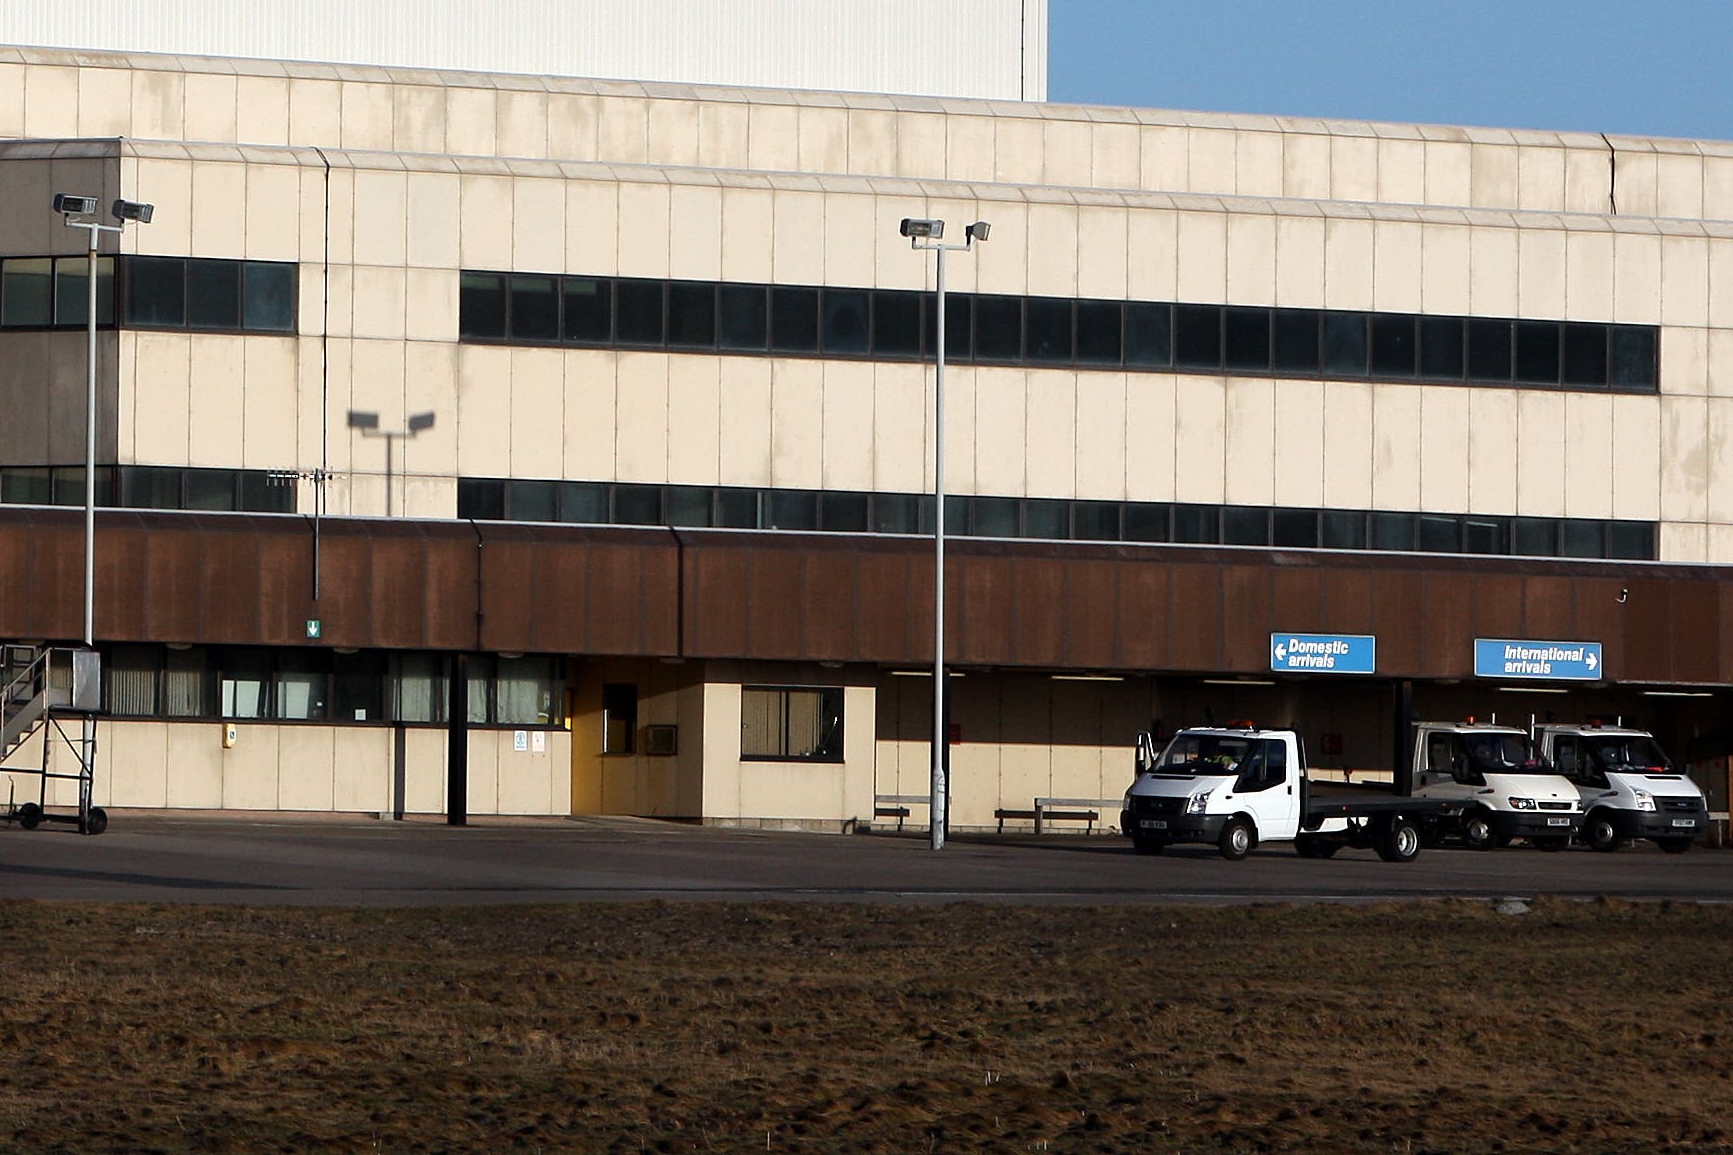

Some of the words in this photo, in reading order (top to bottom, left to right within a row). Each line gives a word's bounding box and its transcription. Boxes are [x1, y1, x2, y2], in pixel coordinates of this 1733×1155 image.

[1288, 638, 1349, 655] Domestic
[1504, 645, 1584, 662] International
[1288, 653, 1335, 669] arrivals
[1504, 660, 1551, 675] arrivals
